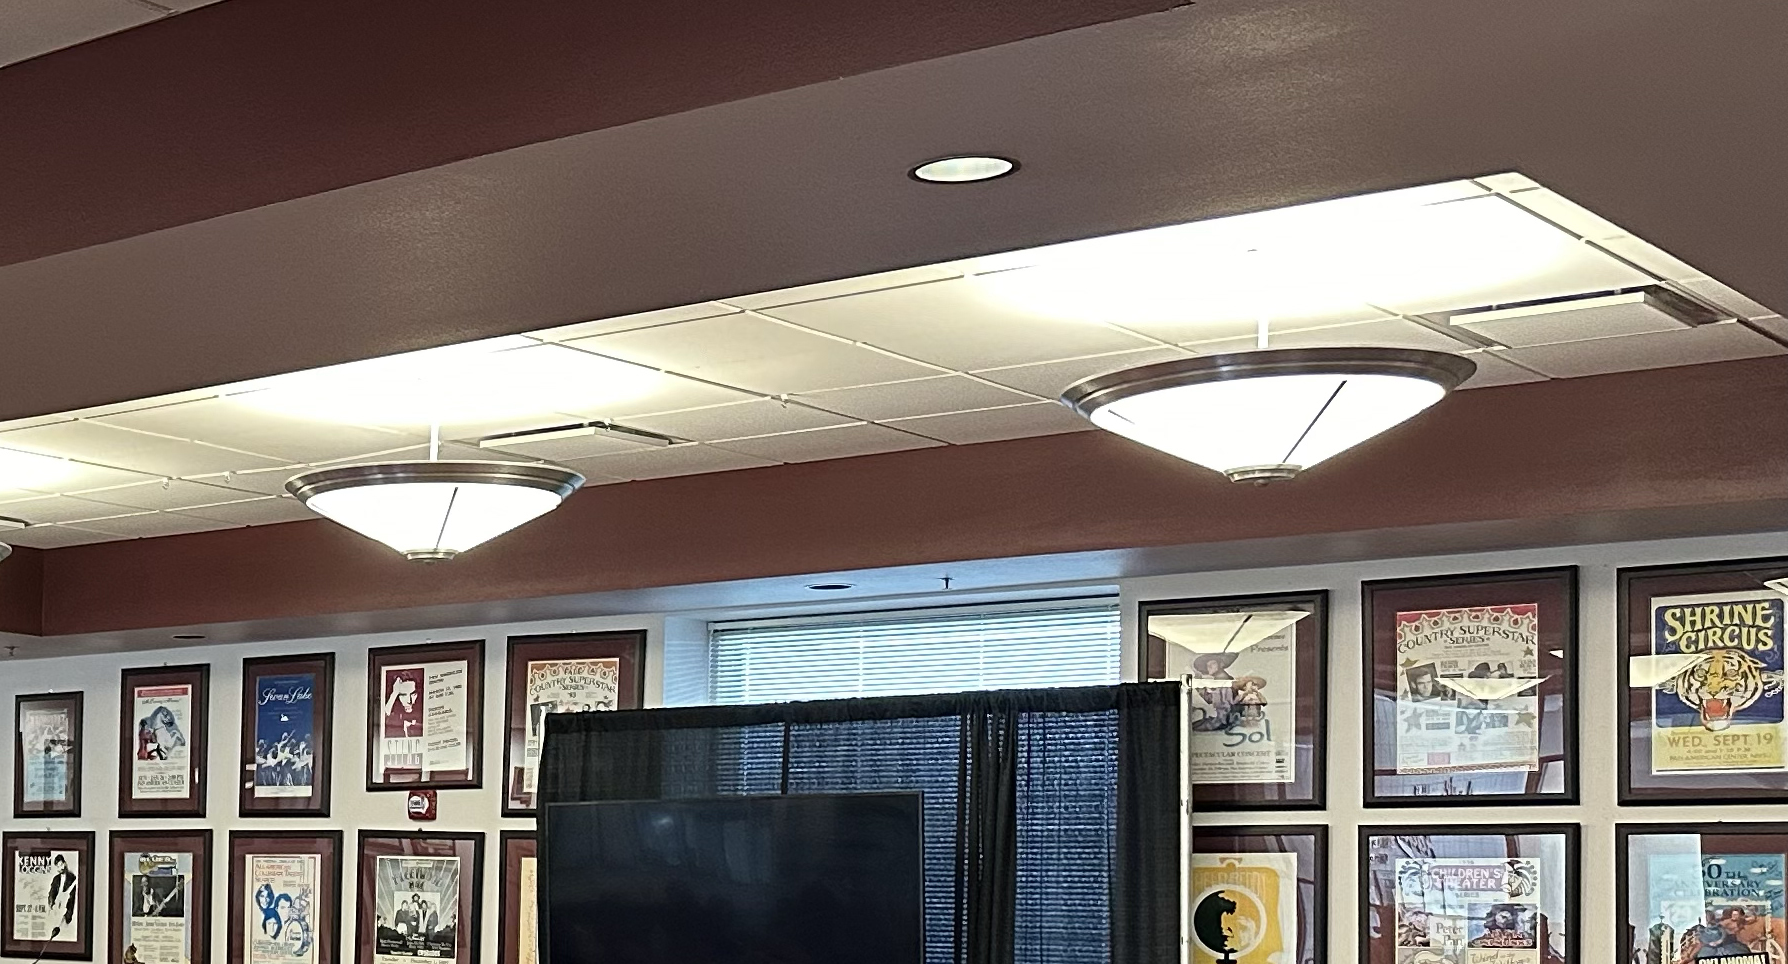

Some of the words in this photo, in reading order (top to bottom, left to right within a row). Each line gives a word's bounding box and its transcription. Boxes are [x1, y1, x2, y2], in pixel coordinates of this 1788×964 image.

[1664, 602, 1775, 643] SHRINE
[1398, 627, 1457, 654] COUNTRY
[1459, 625, 1536, 645] SUPERSTAR
[1449, 636, 1485, 645] SERIES
[1679, 626, 1774, 653] CIRCUS
[530, 677, 568, 695] COUNTRY
[569, 676, 616, 694] SUPERSTAR
[1223, 718, 1272, 747] Sol
[1756, 732, 1773, 746] 19
[18, 855, 51, 866] KENNY
[1431, 867, 1500, 880] CHILDREN'S
[1436, 921, 1464, 934] Peter
